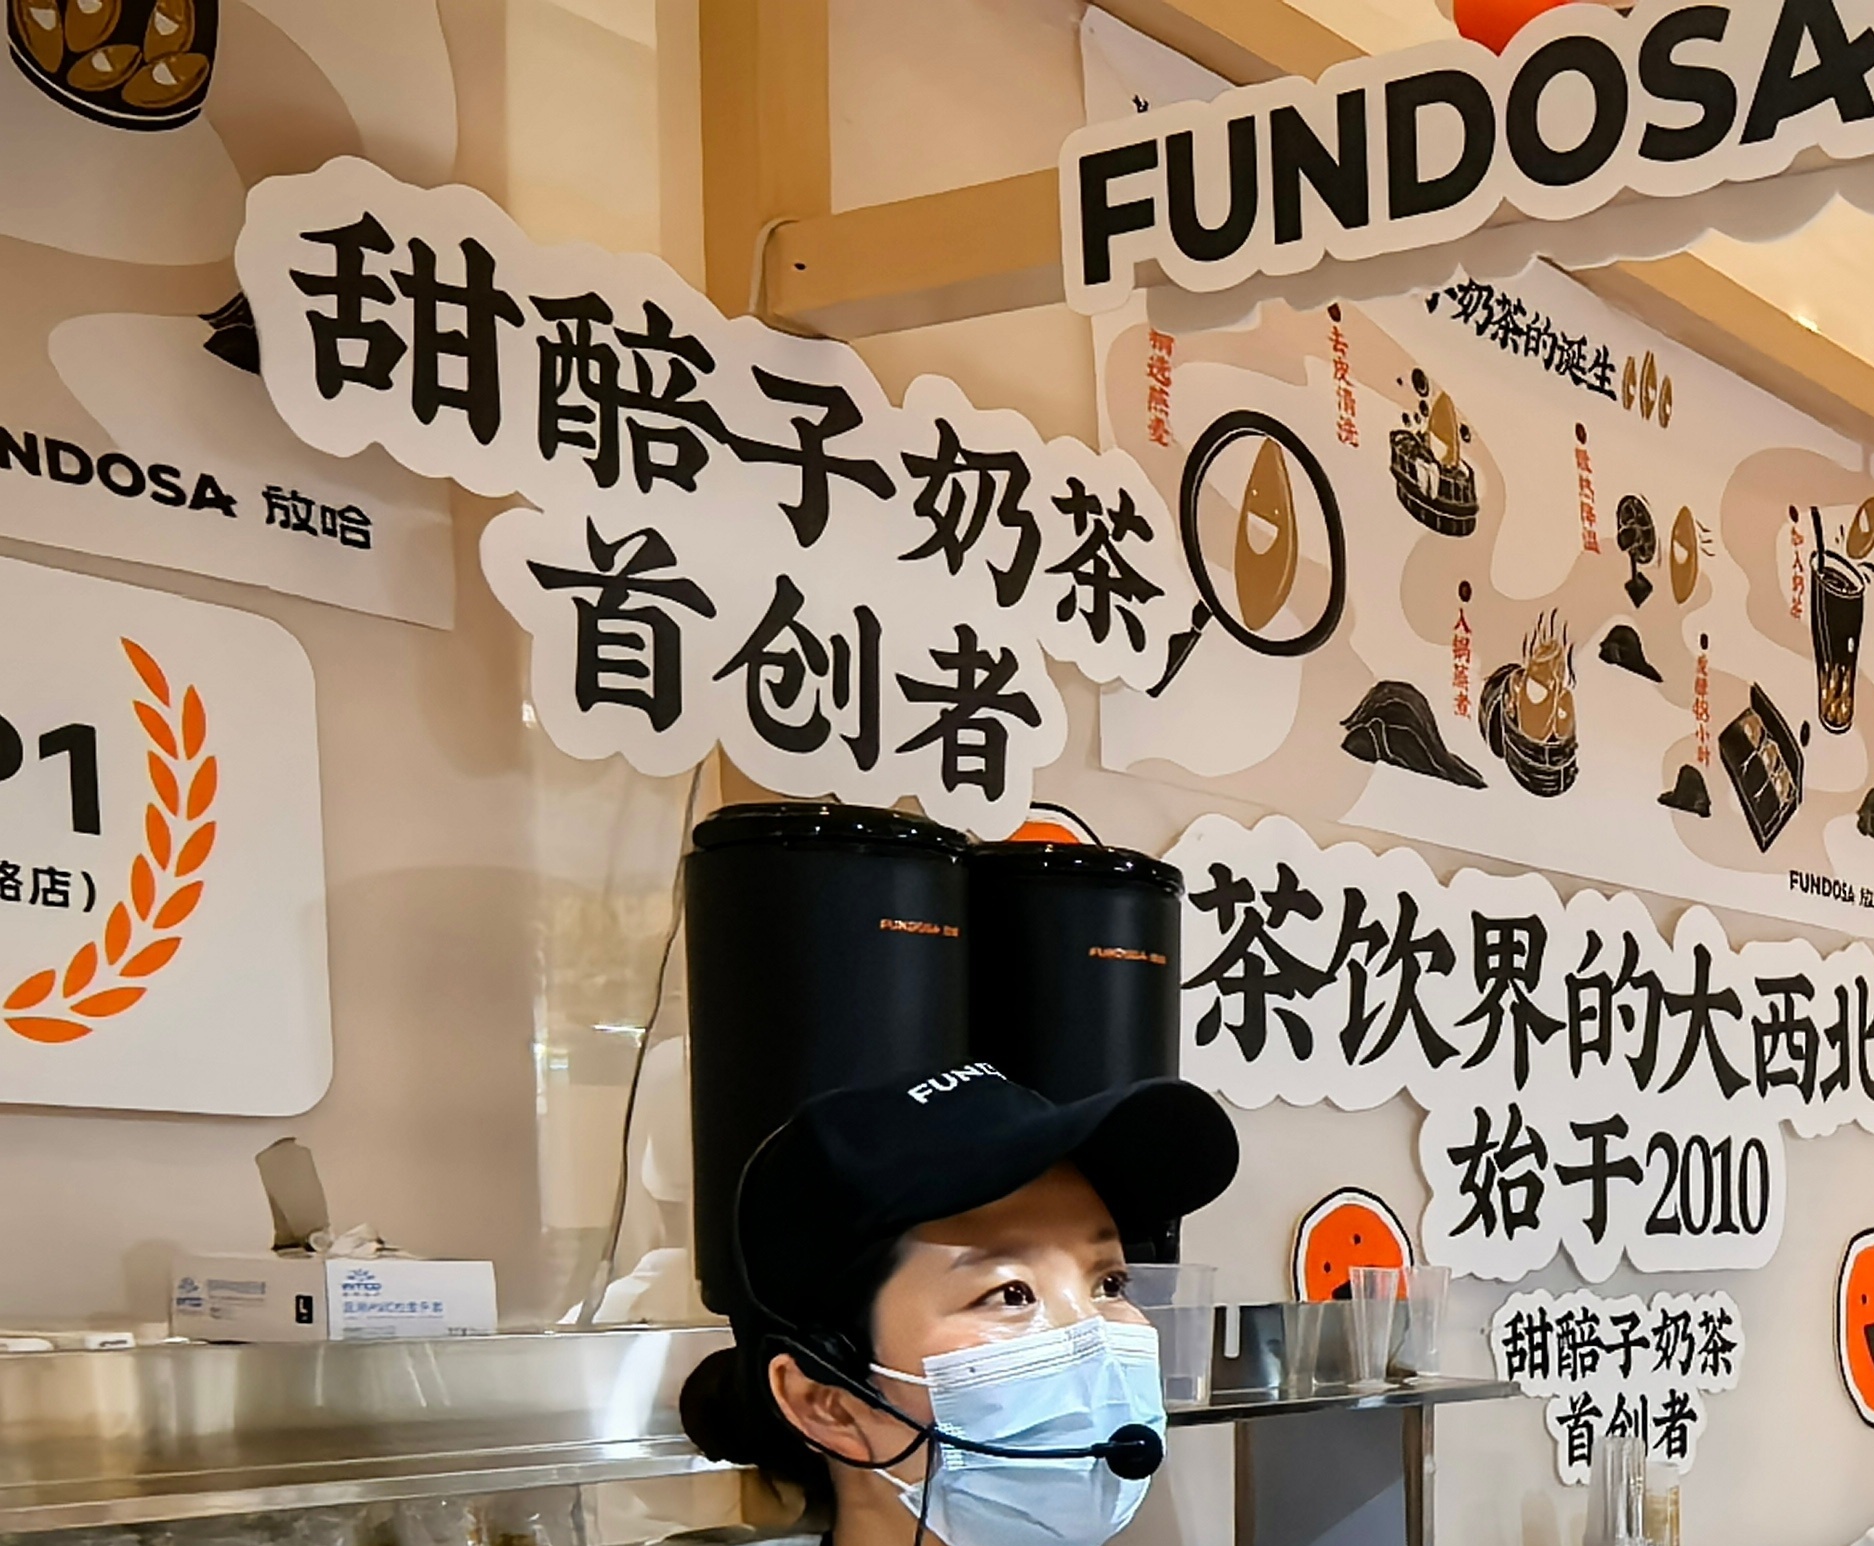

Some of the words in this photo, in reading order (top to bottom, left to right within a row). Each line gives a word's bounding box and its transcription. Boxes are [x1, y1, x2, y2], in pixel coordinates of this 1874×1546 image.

[290, 212, 1165, 652] 甜醅子奶茶
[262, 484, 373, 549] 放哈
[526, 516, 1042, 802] 首创者
[1789, 869, 1855, 905] FUNDOSA
[1448, 1104, 1769, 1245] 始于2010
[1501, 1306, 1738, 1382] 甜醅子奶茶
[1556, 1387, 1698, 1467] 首创者
